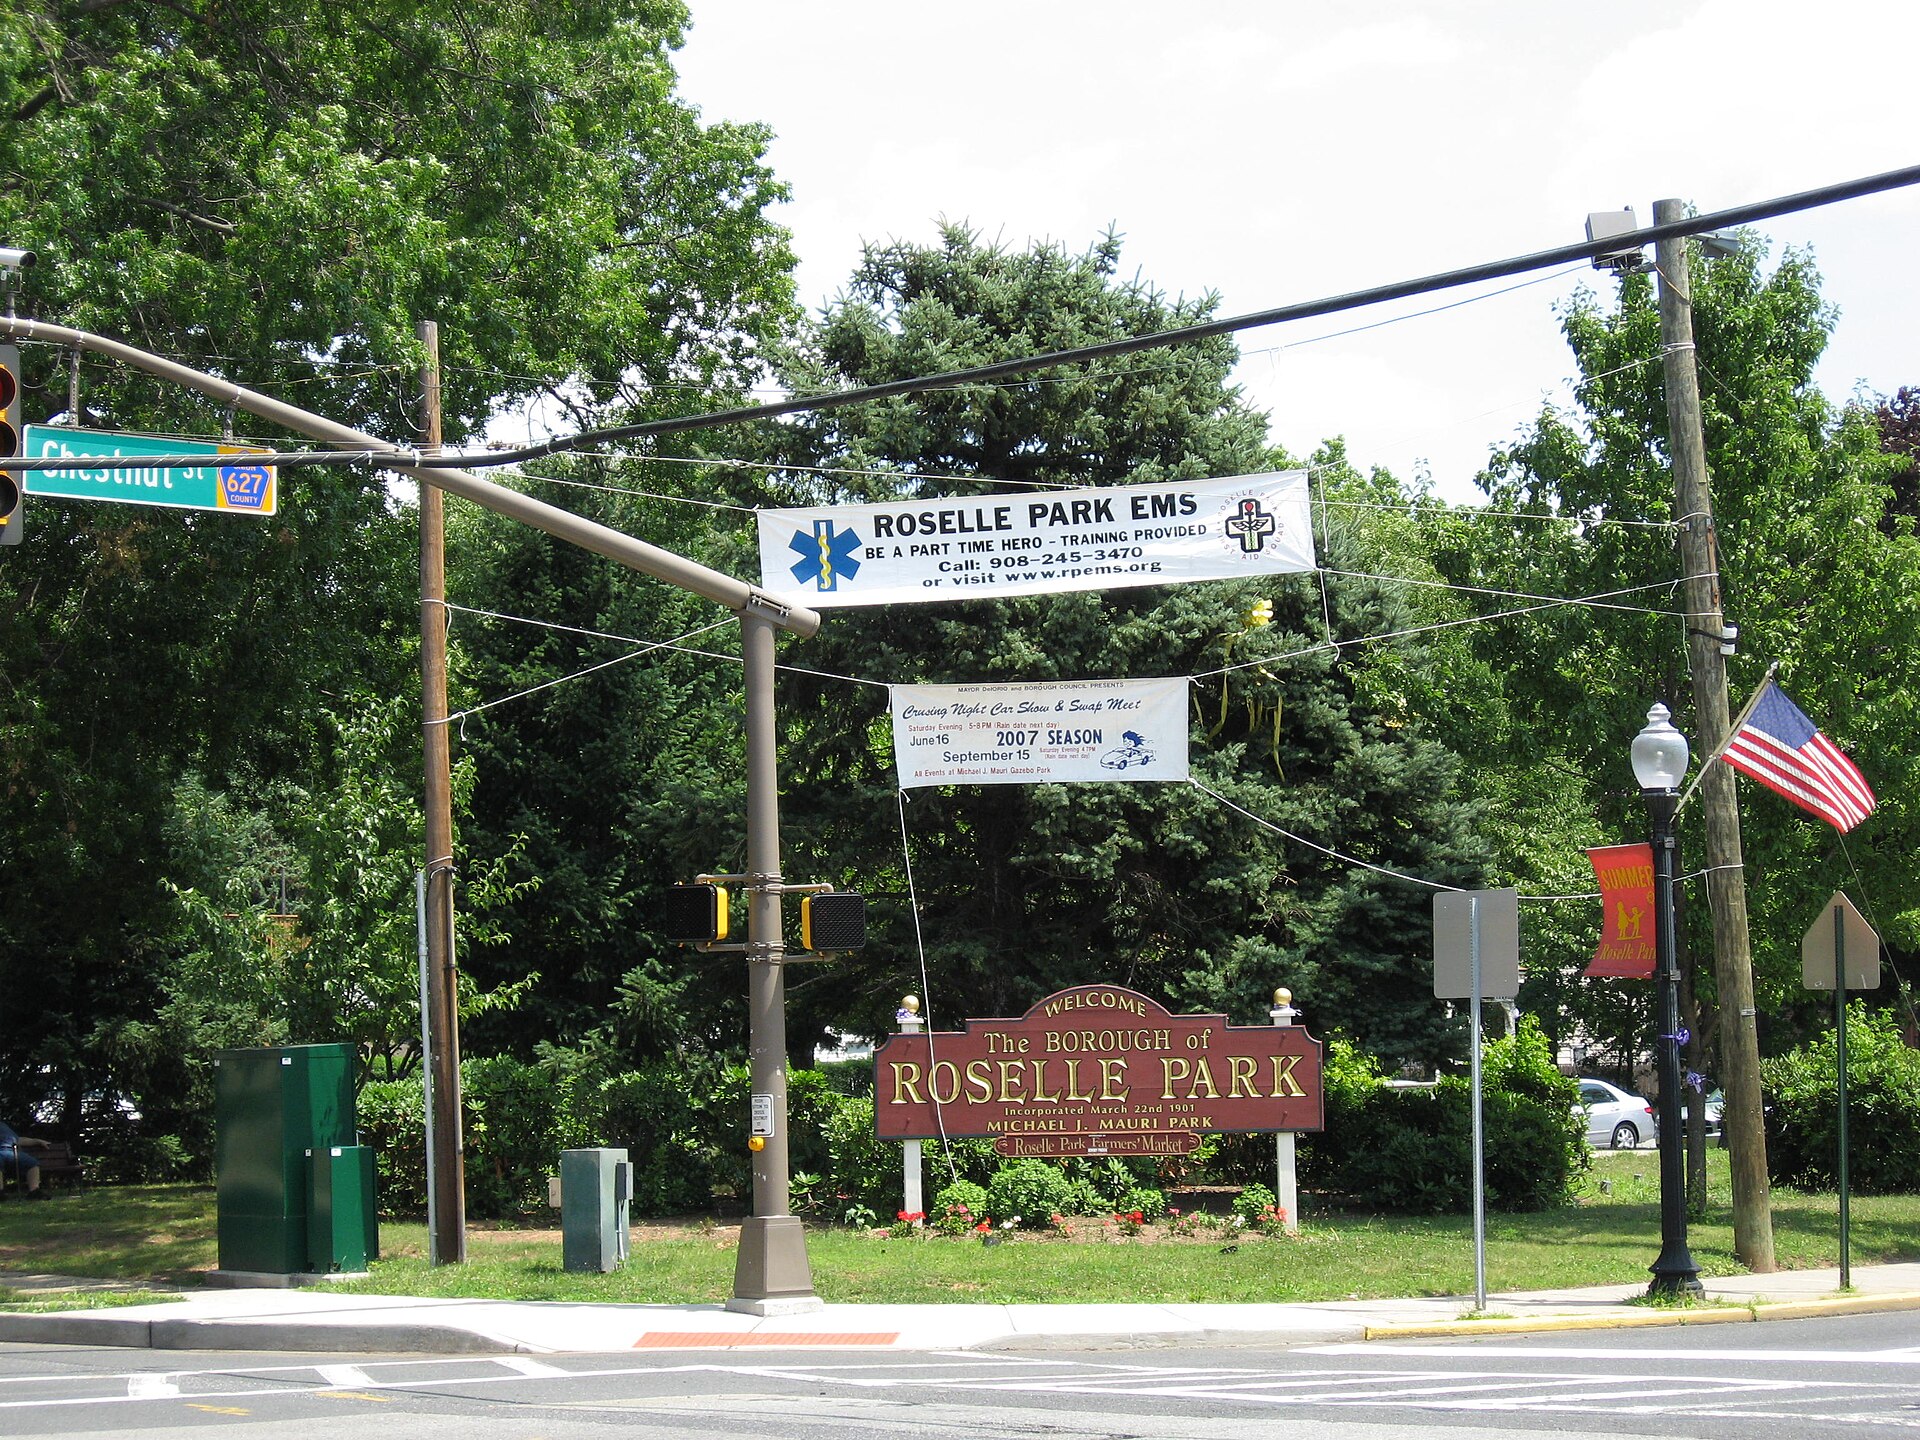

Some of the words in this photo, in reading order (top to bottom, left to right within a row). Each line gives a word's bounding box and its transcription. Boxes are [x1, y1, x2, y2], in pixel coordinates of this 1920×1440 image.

[42, 441, 174, 489] Chestnut
[227, 472, 262, 494] 627
[230, 495, 258, 504] COUNTY
[874, 506, 1012, 538] ROSELLE
[1028, 498, 1115, 528] PARK
[1131, 493, 1198, 520] EMS
[865, 547, 885, 560] BE
[893, 546, 902, 558] A
[910, 543, 950, 557] PART
[958, 540, 994, 554] TIME
[1002, 536, 1042, 550] HERO
[1061, 531, 1128, 546] TRAINING
[1134, 524, 1207, 541] PROVIDED
[938, 560, 981, 573] Call:
[990, 546, 1142, 569] 908-245-3470
[922, 578, 942, 588] or
[952, 572, 996, 586] visit
[1006, 562, 1162, 582] www.rpems.org
[951, 702, 988, 717] Night
[990, 702, 1014, 716] Car
[1017, 701, 1049, 714] Show
[1055, 700, 1065, 712] &
[1069, 699, 1103, 714] Swap
[1106, 698, 1142, 710] Meet
[939, 723, 963, 731] Evening
[997, 731, 1038, 746] 2007
[1048, 729, 1102, 745] SEASON
[910, 736, 935, 747] June
[936, 734, 949, 745] 16
[943, 750, 1014, 764] September
[1017, 750, 1030, 760] 15
[925, 769, 945, 777] Events
[1010, 766, 1034, 774] Gazebo
[1601, 866, 1654, 890] SUMMER
[1600, 943, 1633, 960] Roselle
[1045, 992, 1146, 1018] WELCOME
[984, 1031, 1030, 1053] The
[1045, 1030, 1171, 1052] BOROUGH
[1186, 1028, 1212, 1049] of
[889, 1056, 1131, 1106] ROSELLE
[1159, 1055, 1308, 1099] PARK
[1005, 1106, 1084, 1117] Incorporated
[1090, 1105, 1128, 1114] March
[1134, 1104, 1163, 1113] 22nd
[1169, 1104, 1195, 1113] 1901
[987, 1120, 1067, 1131] MICHAEL
[1075, 1120, 1088, 1131] J.
[1099, 1118, 1158, 1130] MAURI
[1169, 1117, 1213, 1128] PARK
[1015, 1138, 1054, 1155] Roselle
[1060, 1137, 1085, 1150] Park
[1092, 1136, 1140, 1149] Farmers'
[1142, 1134, 1182, 1153] Market
